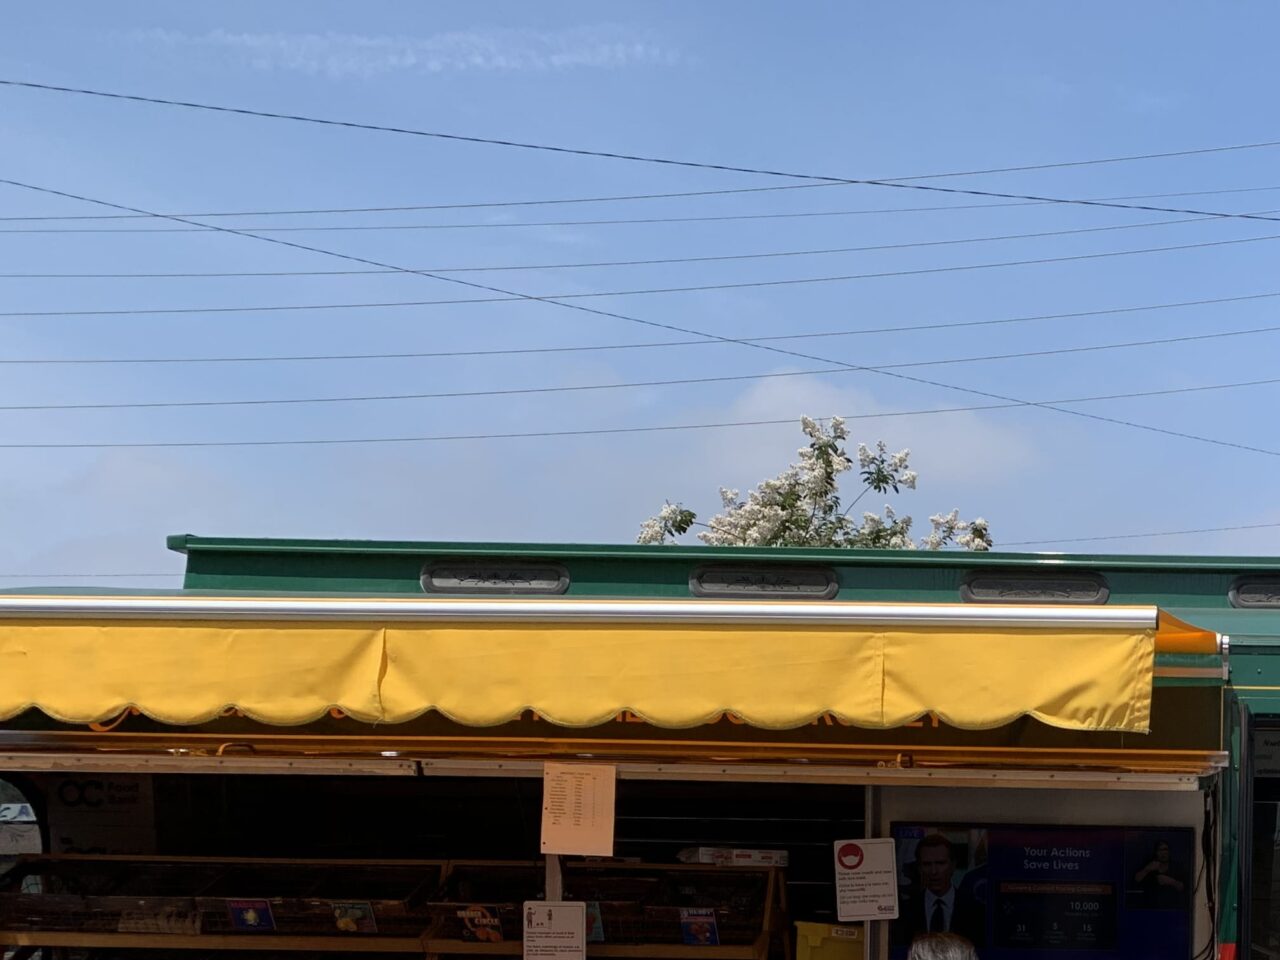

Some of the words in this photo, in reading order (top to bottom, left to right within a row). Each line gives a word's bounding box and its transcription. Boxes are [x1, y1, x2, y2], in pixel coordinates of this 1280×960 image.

[1023, 846, 1047, 857] Your
[1051, 847, 1091, 858] Actions
[1023, 859, 1049, 870] Save
[1053, 859, 1080, 870] Lives
